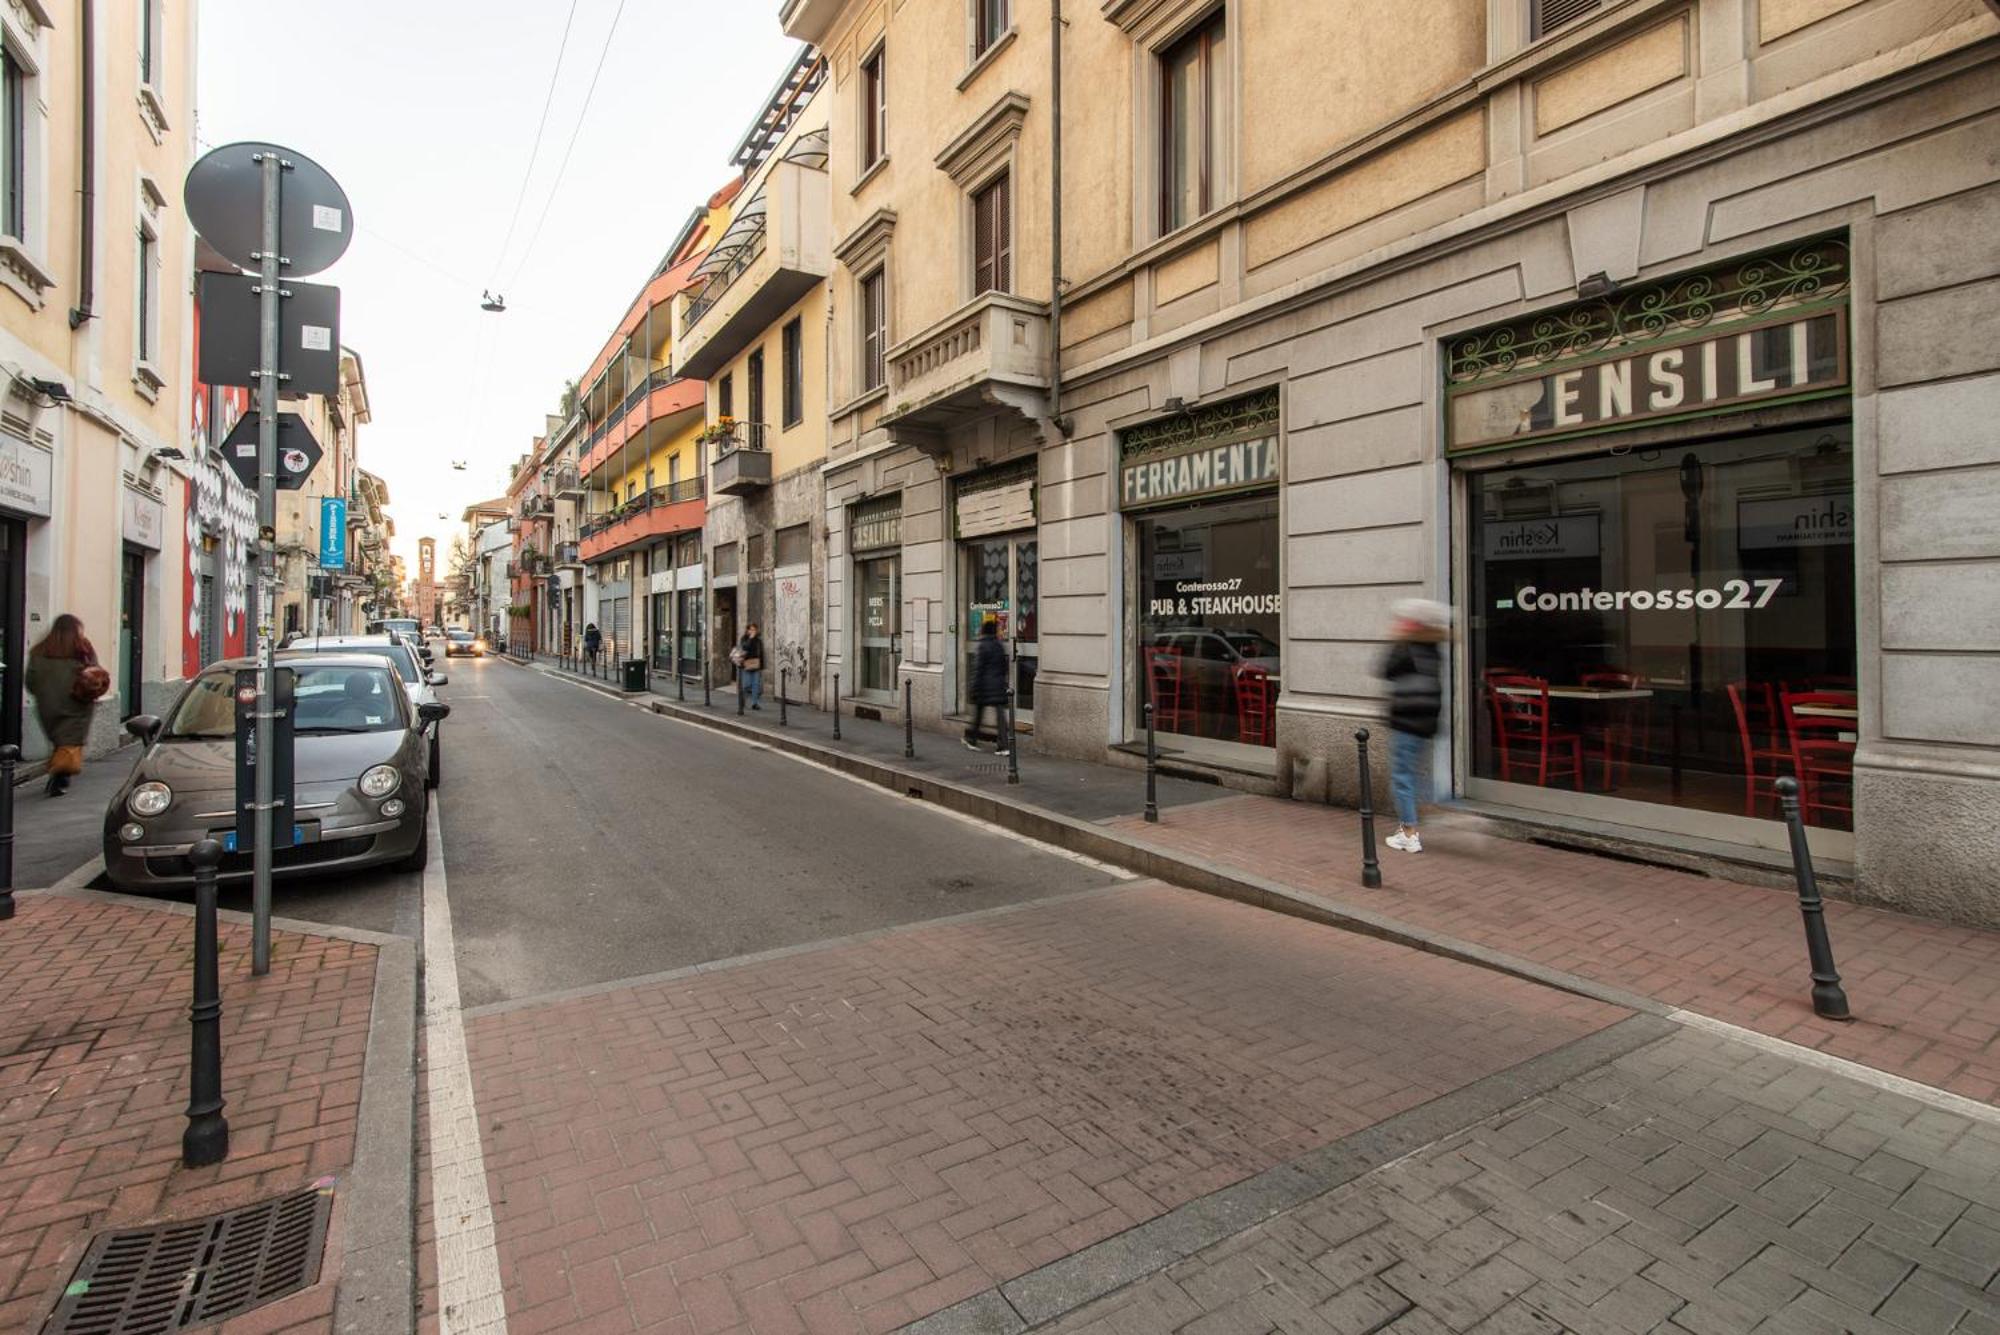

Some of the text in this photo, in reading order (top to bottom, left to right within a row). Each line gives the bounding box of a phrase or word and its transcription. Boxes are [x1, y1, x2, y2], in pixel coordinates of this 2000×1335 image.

[1518, 322, 1809, 433] ENSILI
[1124, 436, 1279, 502] FERRAMENTA
[1176, 579, 1242, 593] Conterosso27
[1516, 578, 1783, 613] Conterosso27
[1150, 595, 1280, 616] PUB & STEAKHOUSE
